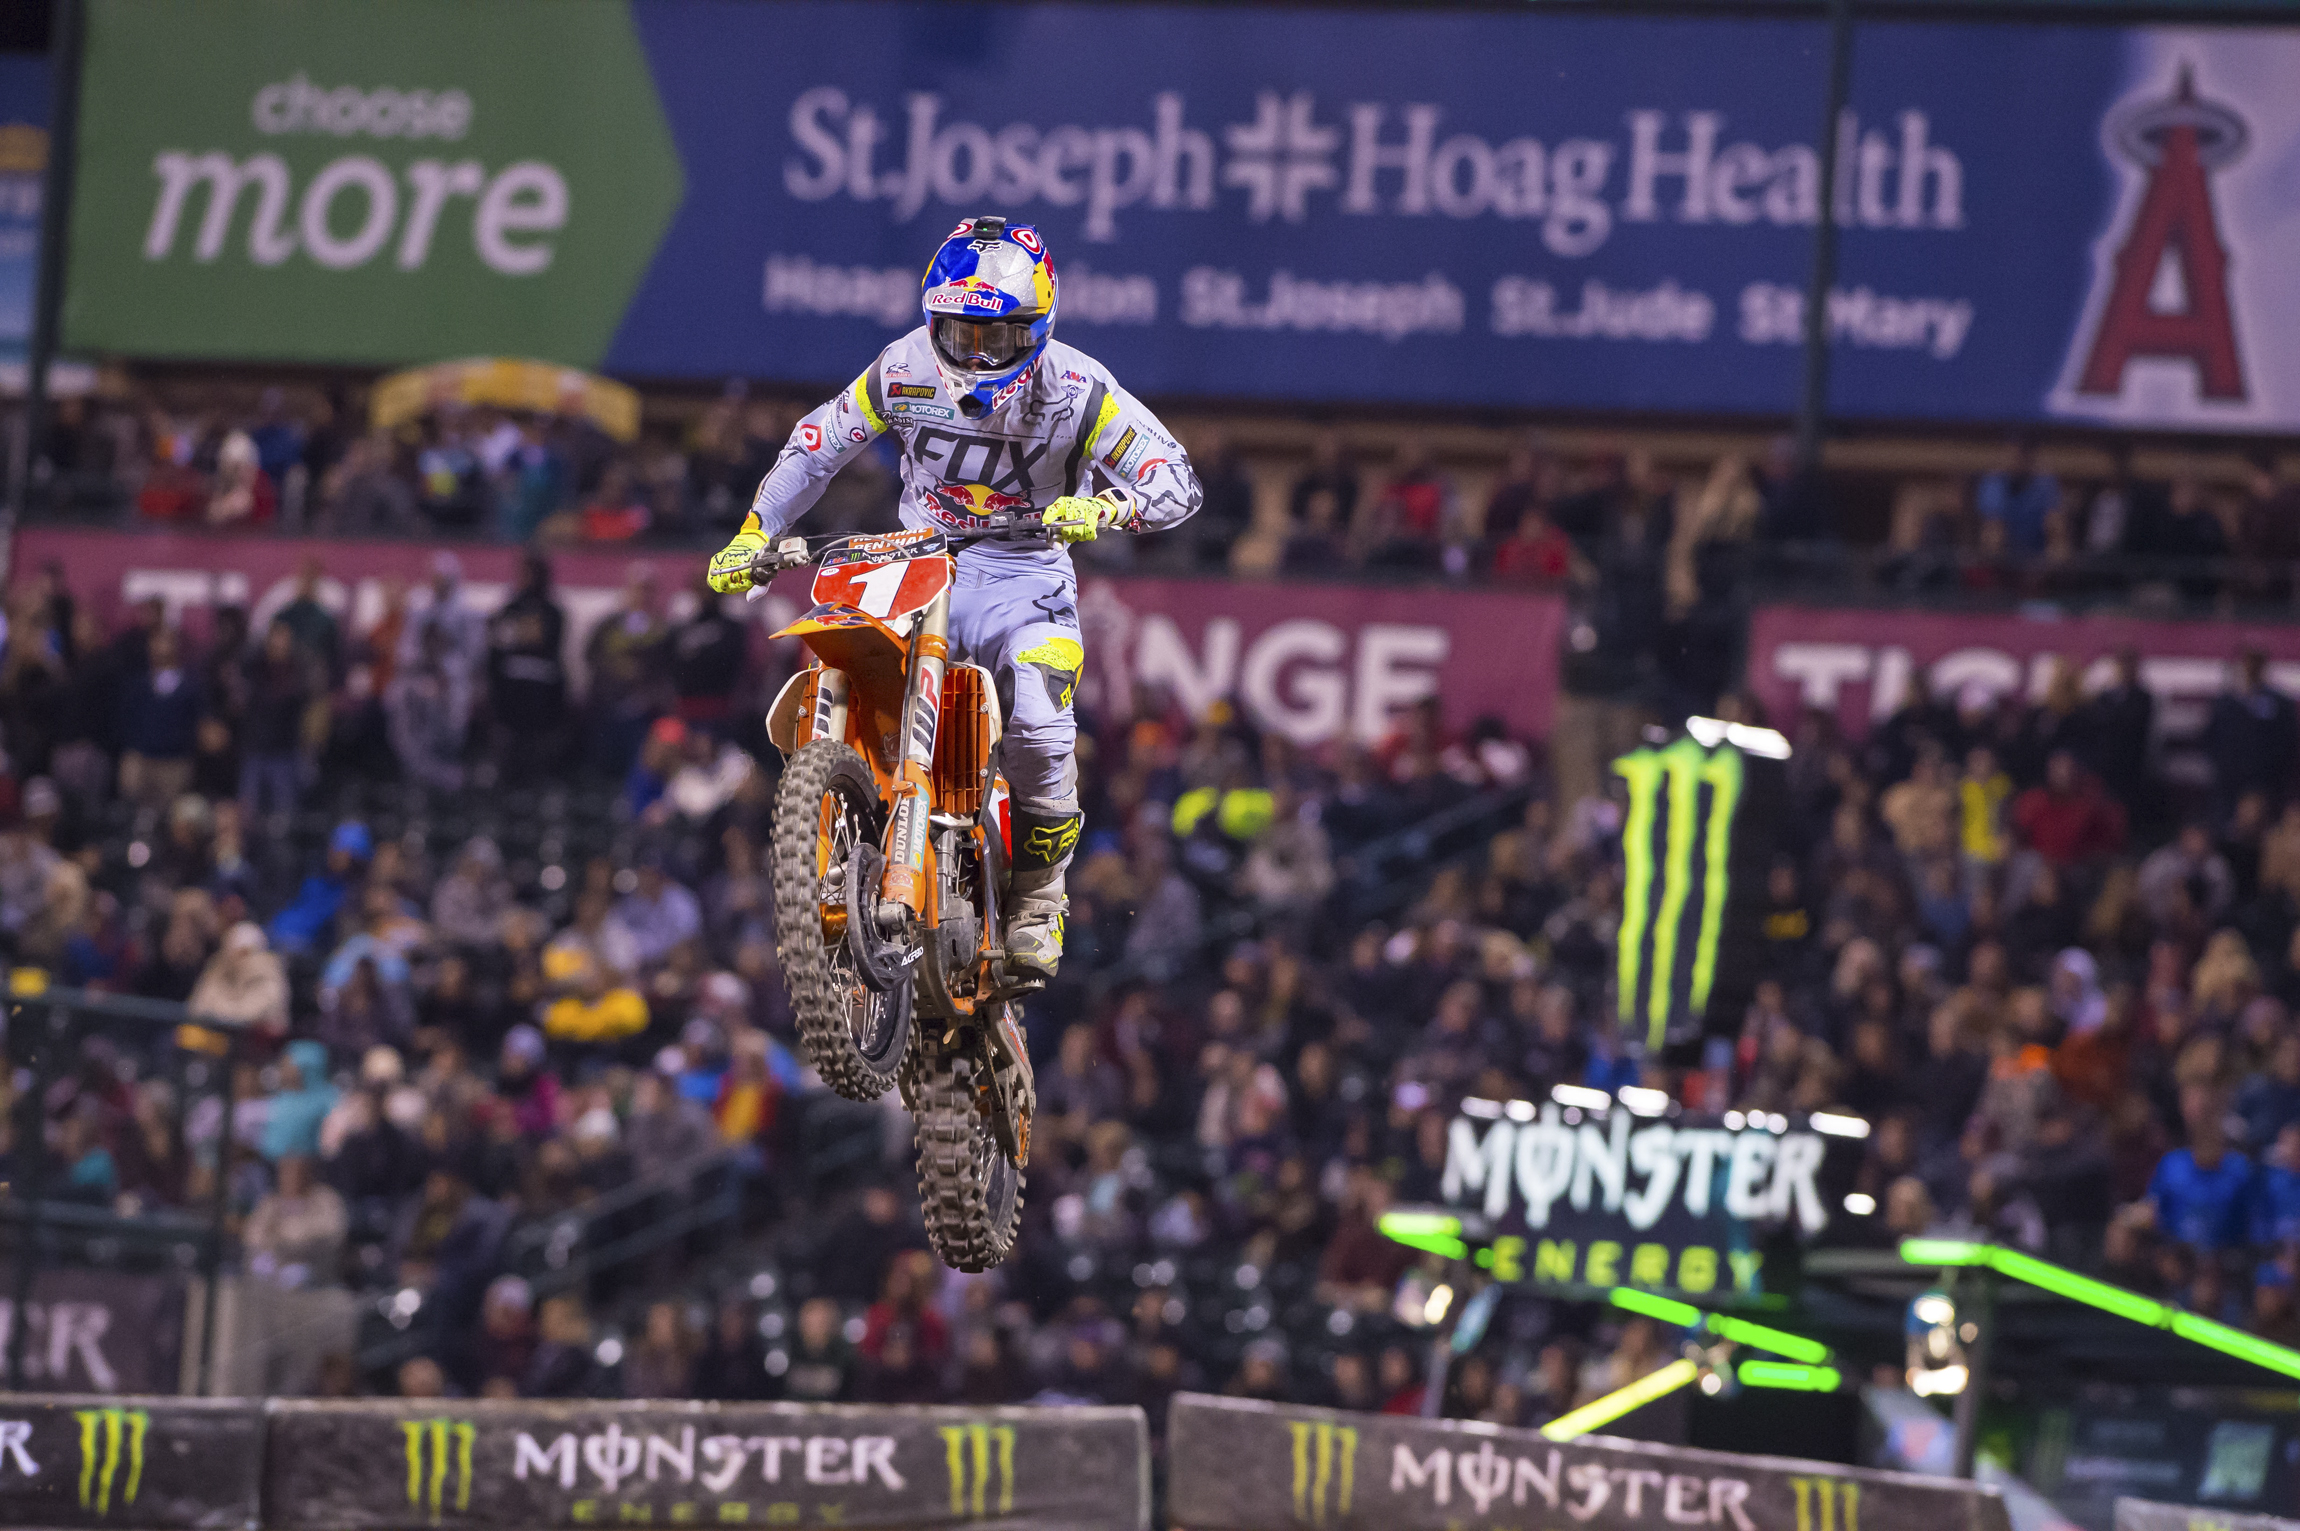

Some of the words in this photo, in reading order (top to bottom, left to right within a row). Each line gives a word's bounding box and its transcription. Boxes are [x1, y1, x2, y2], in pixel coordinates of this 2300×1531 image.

[251, 71, 473, 141] choose
[1341, 101, 1616, 257] Hoag
[1623, 107, 1965, 230] Health
[143, 150, 571, 276] more
[932, 291, 967, 305] Red
[967, 293, 1004, 311] Bull
[1060, 370, 1087, 384] AMA
[909, 404, 951, 418] MOTOREX
[913, 426, 1047, 490] FOX
[1122, 436, 1149, 473] MOTOREX
[849, 560, 912, 618] 1
[914, 798, 927, 854] MOTOREX
[1442, 1103, 1828, 1233] MONSTER
[514, 1424, 907, 1494] MONSTER
[1391, 1441, 1757, 1531] MONSTER
